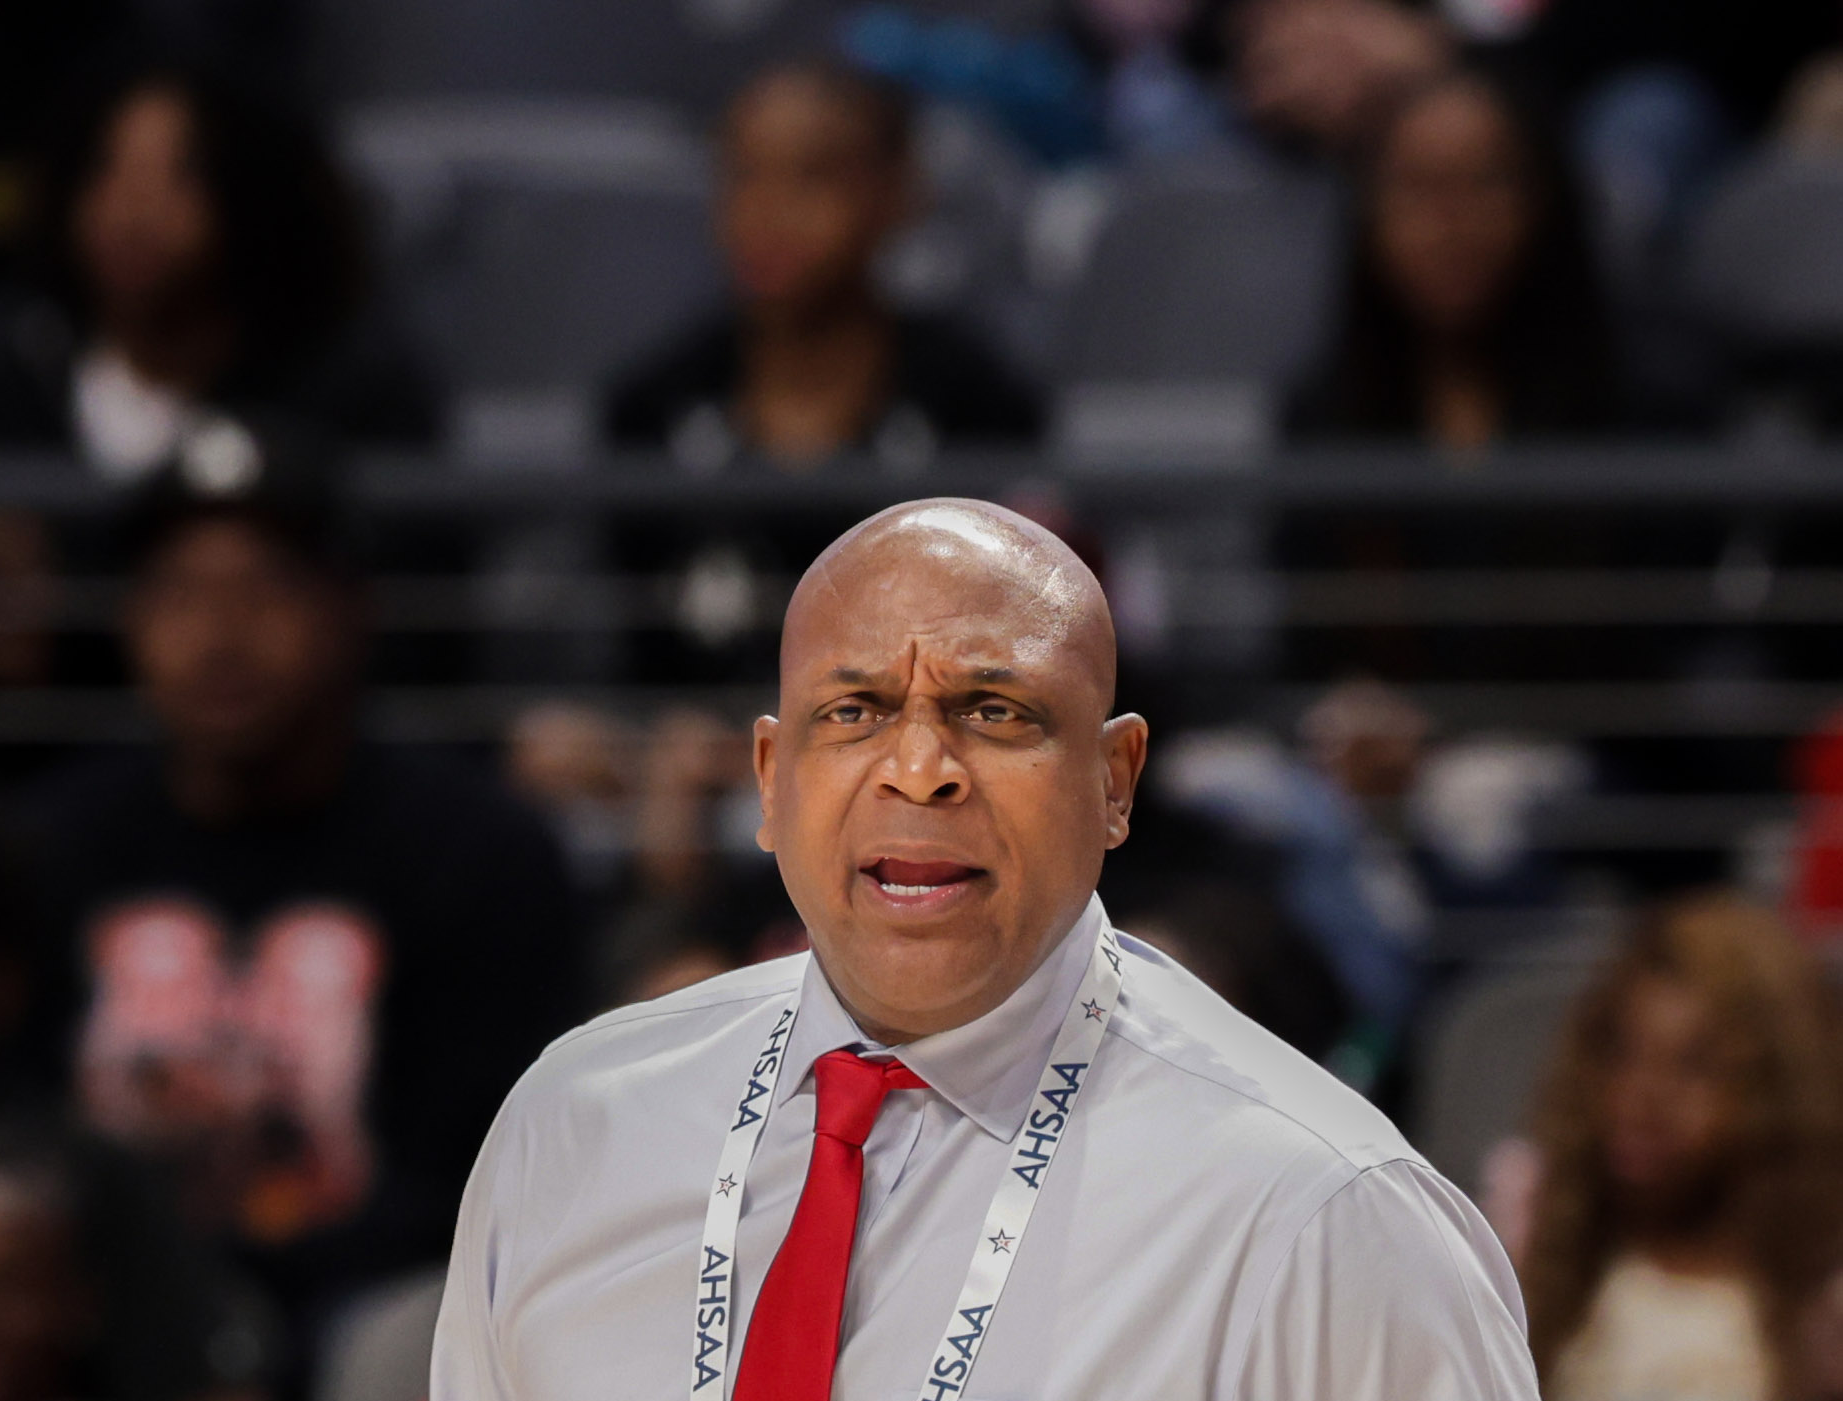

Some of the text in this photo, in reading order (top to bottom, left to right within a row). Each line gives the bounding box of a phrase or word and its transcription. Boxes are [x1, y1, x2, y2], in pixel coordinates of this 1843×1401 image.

[730, 1008, 794, 1132] AHSAA
[1011, 1062, 1089, 1190] AHSAA
[692, 1245, 730, 1392] AHSAA
